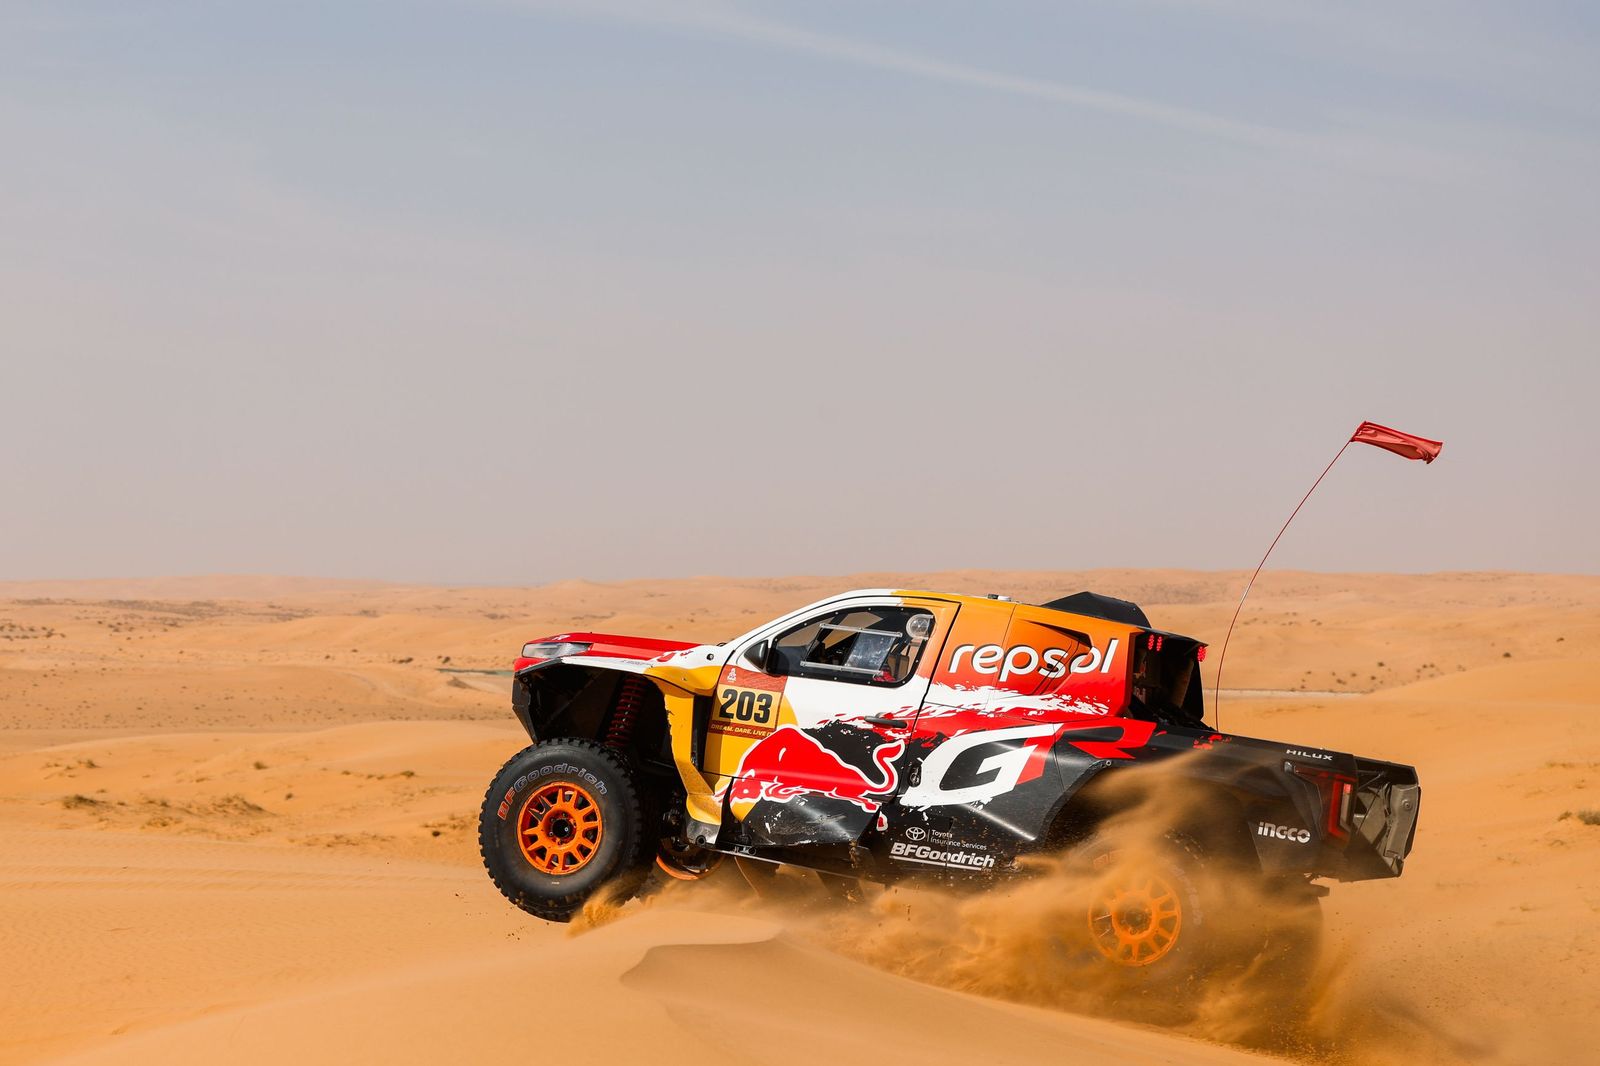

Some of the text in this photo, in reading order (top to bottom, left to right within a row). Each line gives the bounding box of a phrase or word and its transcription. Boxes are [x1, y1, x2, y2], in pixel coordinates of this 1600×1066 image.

[948, 639, 1119, 682] repsol
[719, 689, 773, 723] 203
[752, 729, 766, 737] LIVE
[1286, 749, 1333, 761] HILUX
[497, 762, 608, 821] BFGoodrich
[931, 829, 953, 838] Toyota
[930, 837, 988, 851] Insurance Services
[890, 842, 995, 867] BFGoodrich
